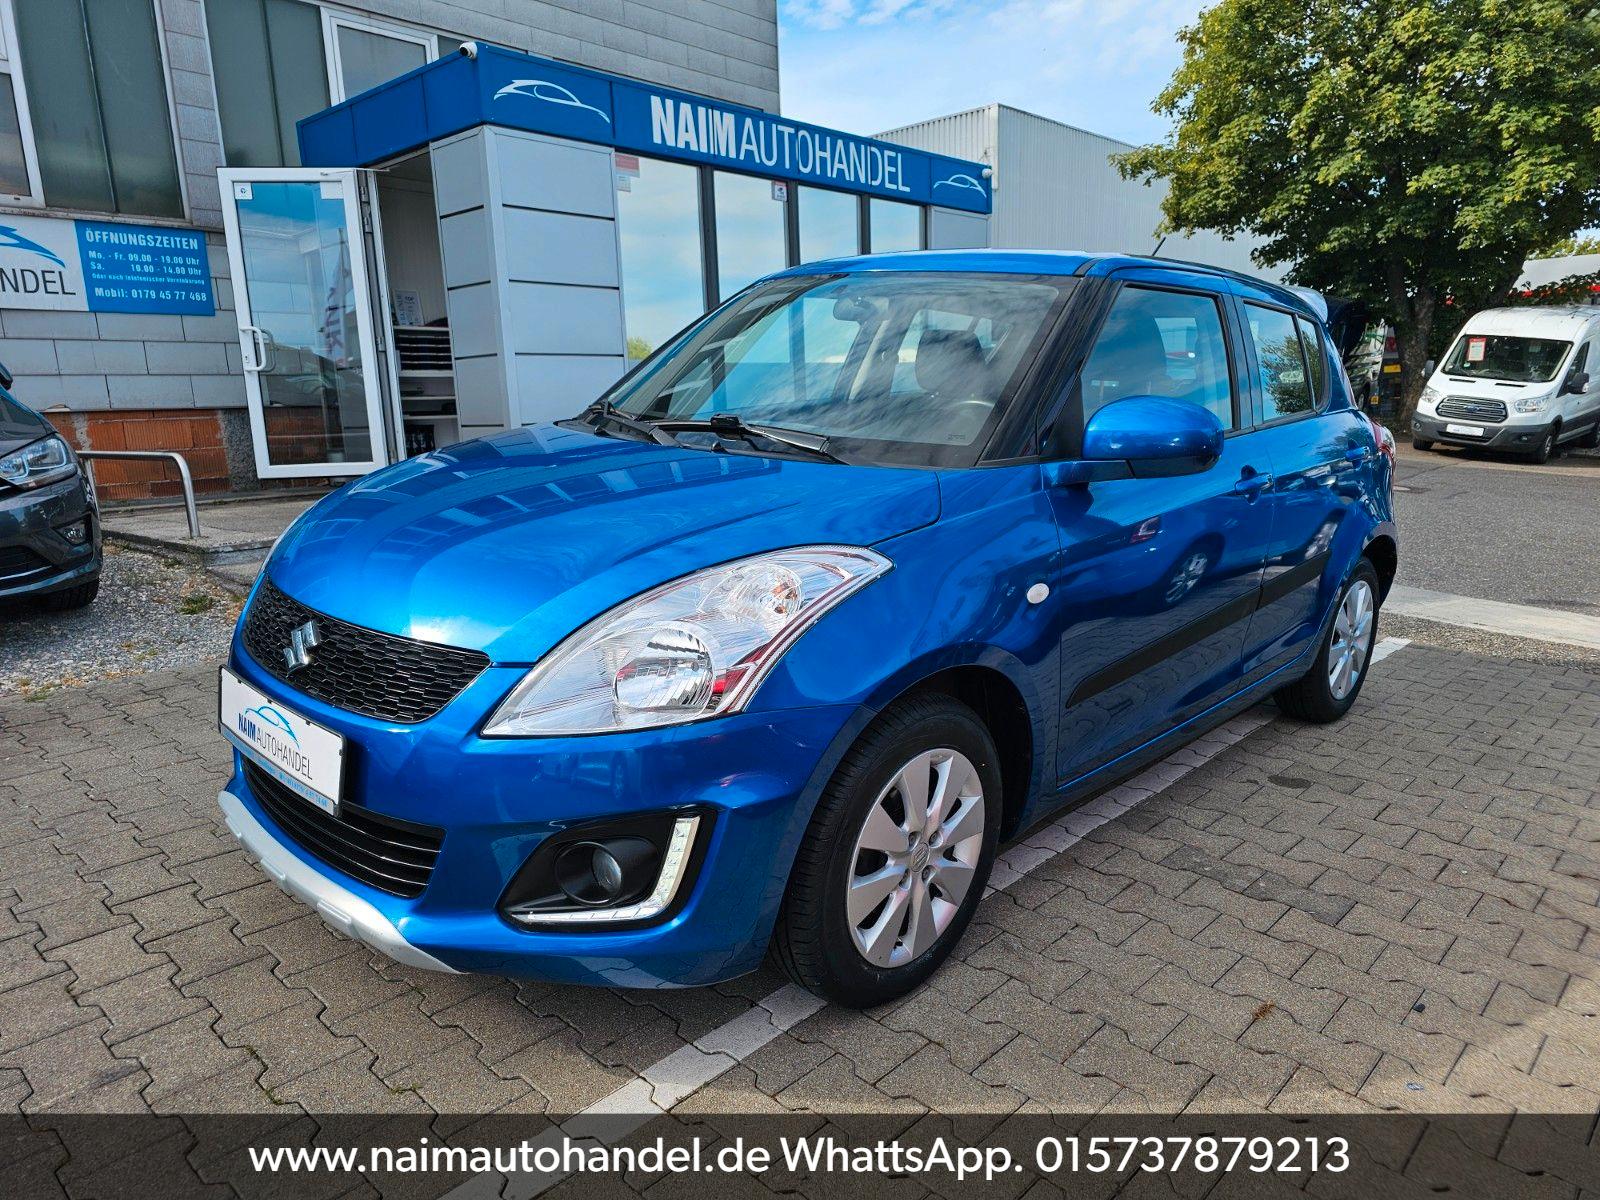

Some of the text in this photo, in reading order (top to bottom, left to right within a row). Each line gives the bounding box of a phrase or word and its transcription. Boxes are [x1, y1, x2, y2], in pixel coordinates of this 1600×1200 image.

[85, 227, 198, 250] ÖFFNUNGSZEITEN
[88, 250, 105, 260] Mo.
[114, 252, 126, 261] Fr.
[128, 253, 152, 262] 09.00
[161, 255, 184, 264] 19.00
[186, 257, 199, 265] Uhr
[90, 261, 105, 270] Sa.
[163, 266, 186, 275] 14.00
[188, 267, 201, 276] Uhr
[95, 287, 207, 302] Mobil: 0179 45 77 468
